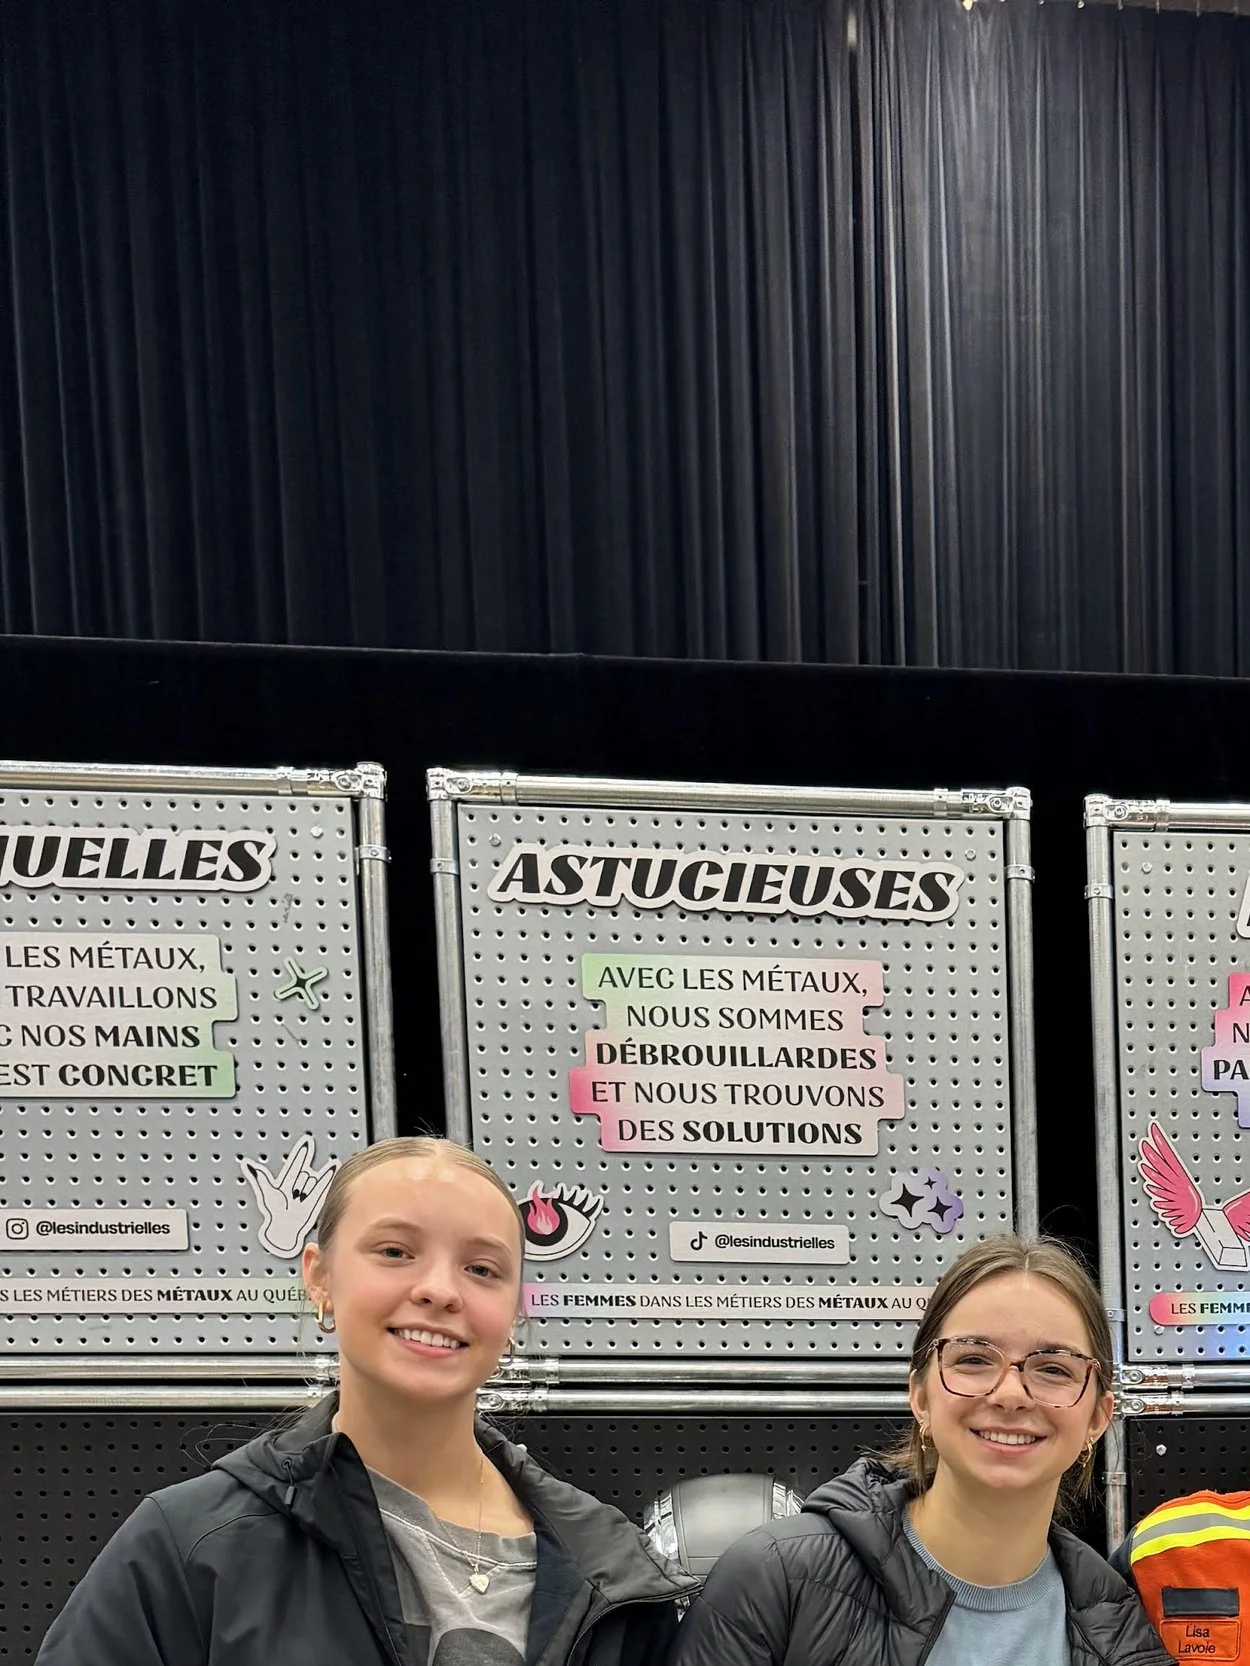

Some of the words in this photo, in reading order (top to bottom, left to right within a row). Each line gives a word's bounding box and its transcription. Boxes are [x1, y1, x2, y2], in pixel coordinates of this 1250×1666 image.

[0, 835, 270, 884] UELLES
[498, 851, 957, 913] ASTUCIEUSES
[5, 945, 61, 969] LES
[69, 940, 206, 974] MÉTAUX,
[598, 967, 675, 989] AVEC
[682, 967, 734, 991] LES
[742, 964, 868, 996] MÉTAUX,
[5, 985, 217, 1010] TRAVAILLONS
[627, 1005, 710, 1029] NOUS
[718, 1006, 844, 1032] SOMMES
[21, 1024, 86, 1047] NOS
[95, 1025, 200, 1048] MAINS
[596, 1038, 878, 1070] DÉBROUILLARDES
[58, 1063, 218, 1087] CONCRET
[591, 1081, 626, 1104] ET
[633, 1082, 718, 1106] NOUS
[723, 1084, 886, 1109] TROUVONS
[617, 1120, 676, 1142] DES
[682, 1122, 863, 1145] SOLUTIONS
[35, 1219, 170, 1238] @lesindustrielles
[714, 1233, 835, 1251] @lesindustrielles
[14, 1289, 43, 1302] LES
[47, 1286, 117, 1302] MÉTIERS
[121, 1289, 153, 1302] DES
[157, 1286, 233, 1301] MÉTAUX
[236, 1289, 258, 1301] AU
[263, 1286, 313, 1304] QUÉB
[531, 1294, 559, 1306] LES
[563, 1295, 636, 1307] FEMMES
[640, 1295, 682, 1307] DANS
[686, 1296, 713, 1307] LES
[717, 1293, 782, 1308] MÉTIERS
[786, 1296, 815, 1308] DES
[818, 1294, 889, 1308] MÉTAUX
[891, 1298, 912, 1309] AU
[1171, 1303, 1196, 1314] LES
[1186, 1624, 1210, 1638] Lisa
[1178, 1640, 1216, 1653] Lavoie
